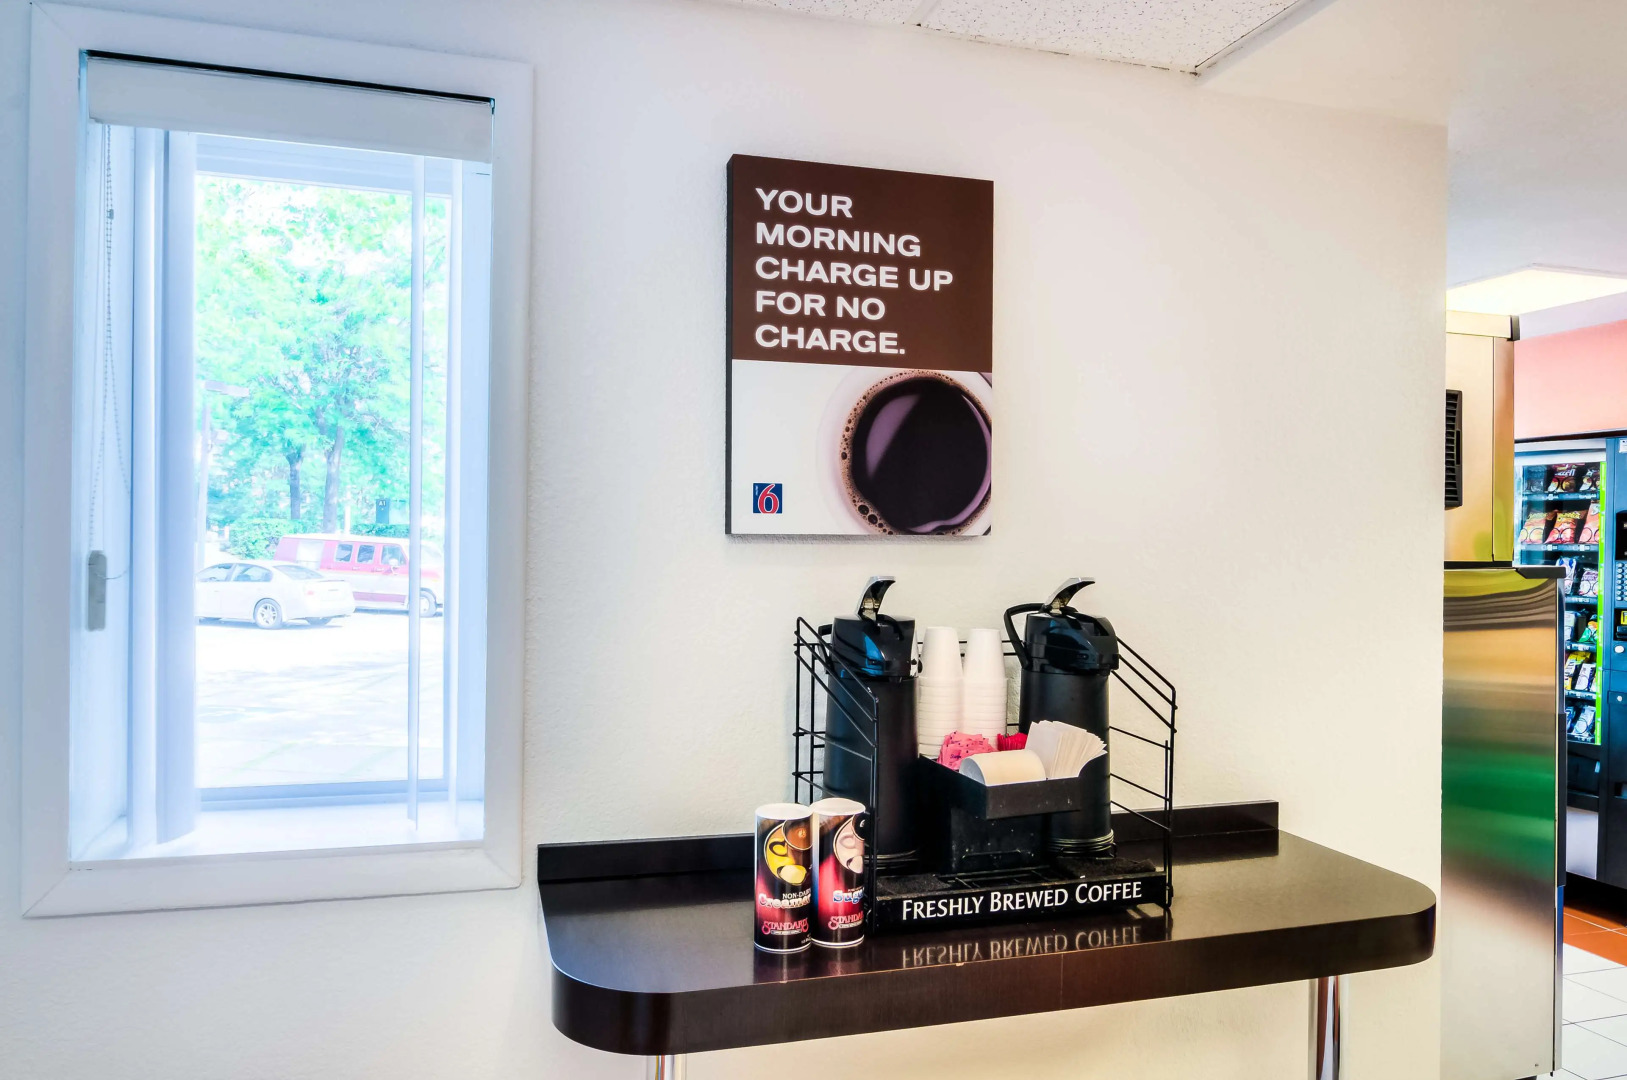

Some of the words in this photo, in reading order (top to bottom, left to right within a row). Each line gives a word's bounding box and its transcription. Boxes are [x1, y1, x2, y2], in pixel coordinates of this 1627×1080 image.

[755, 187, 853, 218] YOUR
[755, 222, 921, 258] MORNING
[755, 256, 899, 289] CHARGE
[909, 268, 953, 292] UP
[755, 290, 826, 317] FOR
[836, 296, 886, 320] NO
[755, 324, 906, 355] CHARGE.
[757, 483, 780, 514] 6
[902, 895, 984, 921] FRESHLY
[990, 888, 1069, 913] BREWED
[1075, 881, 1143, 904] COFFEE
[761, 917, 809, 935] STANDARD
